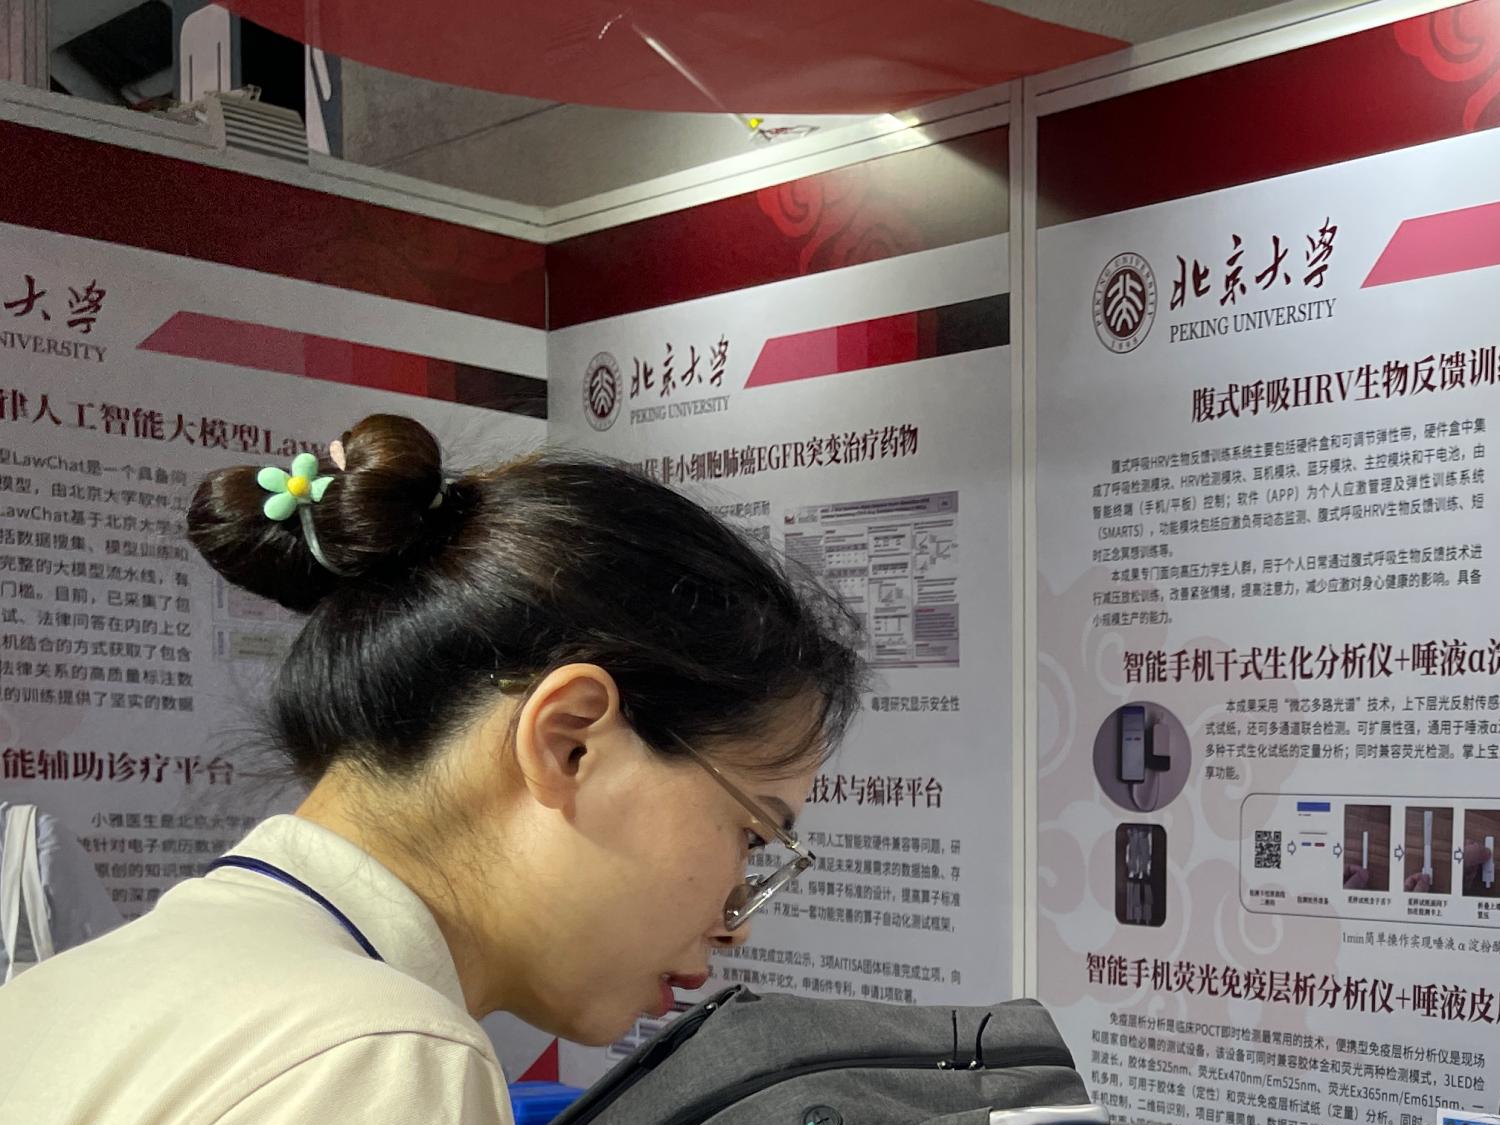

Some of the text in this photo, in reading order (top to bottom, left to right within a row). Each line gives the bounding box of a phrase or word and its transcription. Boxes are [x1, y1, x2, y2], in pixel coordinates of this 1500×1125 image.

[1170, 298, 1338, 344] PEKING UNIVERSITY
[630, 395, 731, 426] PEKING UNIVERSITY
[806, 774, 943, 809] 技术与编译平台
